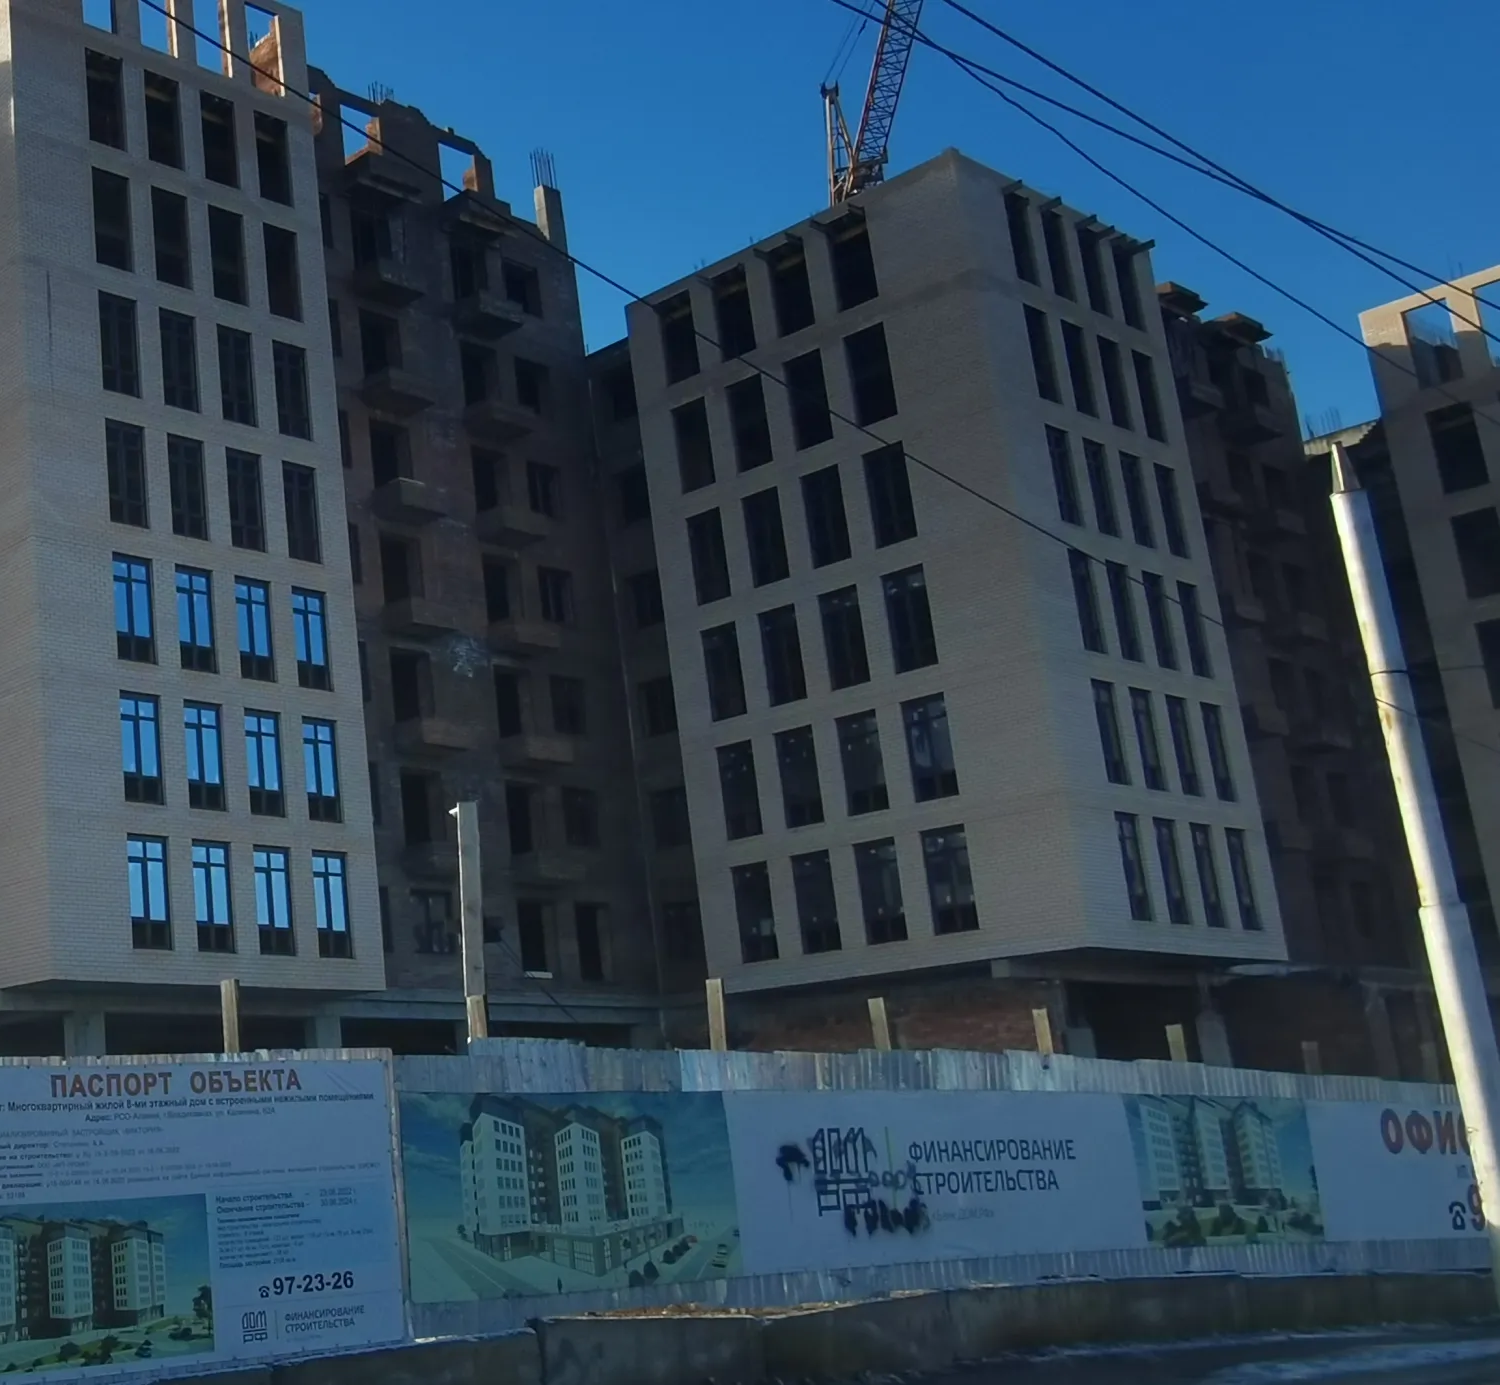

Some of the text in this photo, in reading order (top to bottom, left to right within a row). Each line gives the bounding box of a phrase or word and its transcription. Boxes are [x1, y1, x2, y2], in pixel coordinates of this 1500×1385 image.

[49, 1068, 303, 1098] ПАСПОРТ ОБЪЕКТА
[7, 1100, 93, 1114] Многоквартирный
[95, 1099, 124, 1110] жилой
[149, 1096, 187, 1108] этажный
[189, 1098, 206, 1108] дом
[215, 1095, 272, 1107] встроенными
[908, 1138, 1077, 1164] ФИНАНСИРОВАНИЕ
[912, 1168, 1061, 1195] СТРОИТЕЛЬСТВА
[215, 1195, 241, 1203] Начало
[272, 1270, 354, 1296] 97-23-26
[241, 1310, 267, 1330] ДОМ
[284, 1304, 365, 1321] ФИНАНСИРОВАНИЕ
[285, 1317, 356, 1334] СТРОИТЕЛЬСТВА
